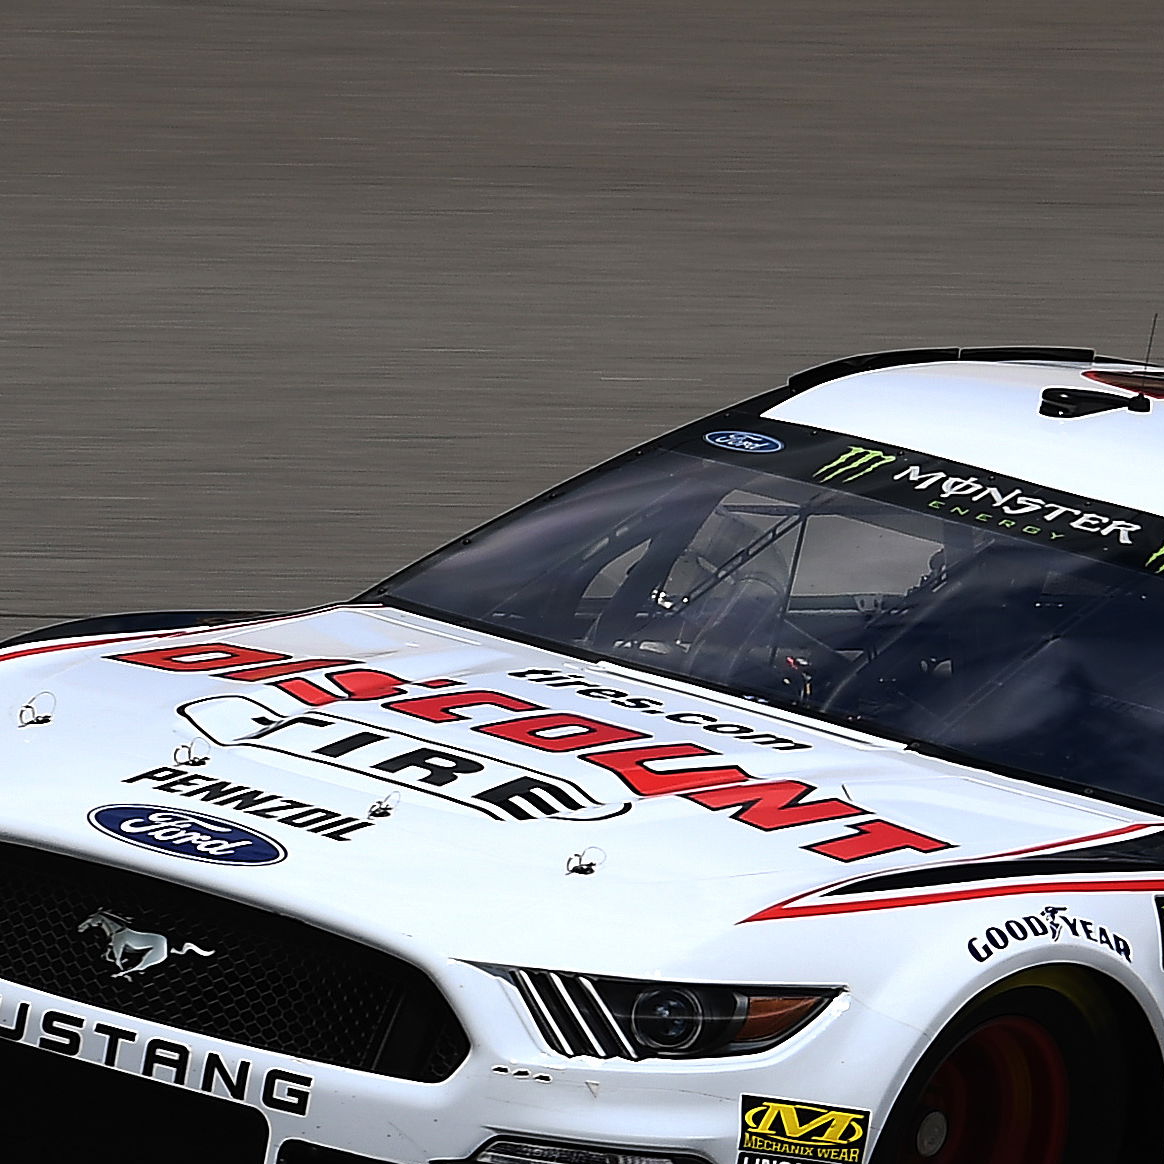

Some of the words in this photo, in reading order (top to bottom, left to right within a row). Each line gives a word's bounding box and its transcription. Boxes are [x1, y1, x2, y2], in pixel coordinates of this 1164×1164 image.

[715, 434, 770, 450] Ford
[927, 500, 1066, 540] ENERGY
[507, 667, 813, 751] tires.com
[101, 642, 960, 863] DISCOUNT
[233, 715, 584, 820] TIRE
[120, 807, 250, 858] Ford
[121, 765, 377, 842] PENNZOIL
[743, 1132, 814, 1157] MECHANIX
[817, 1147, 860, 1163] WEAR
